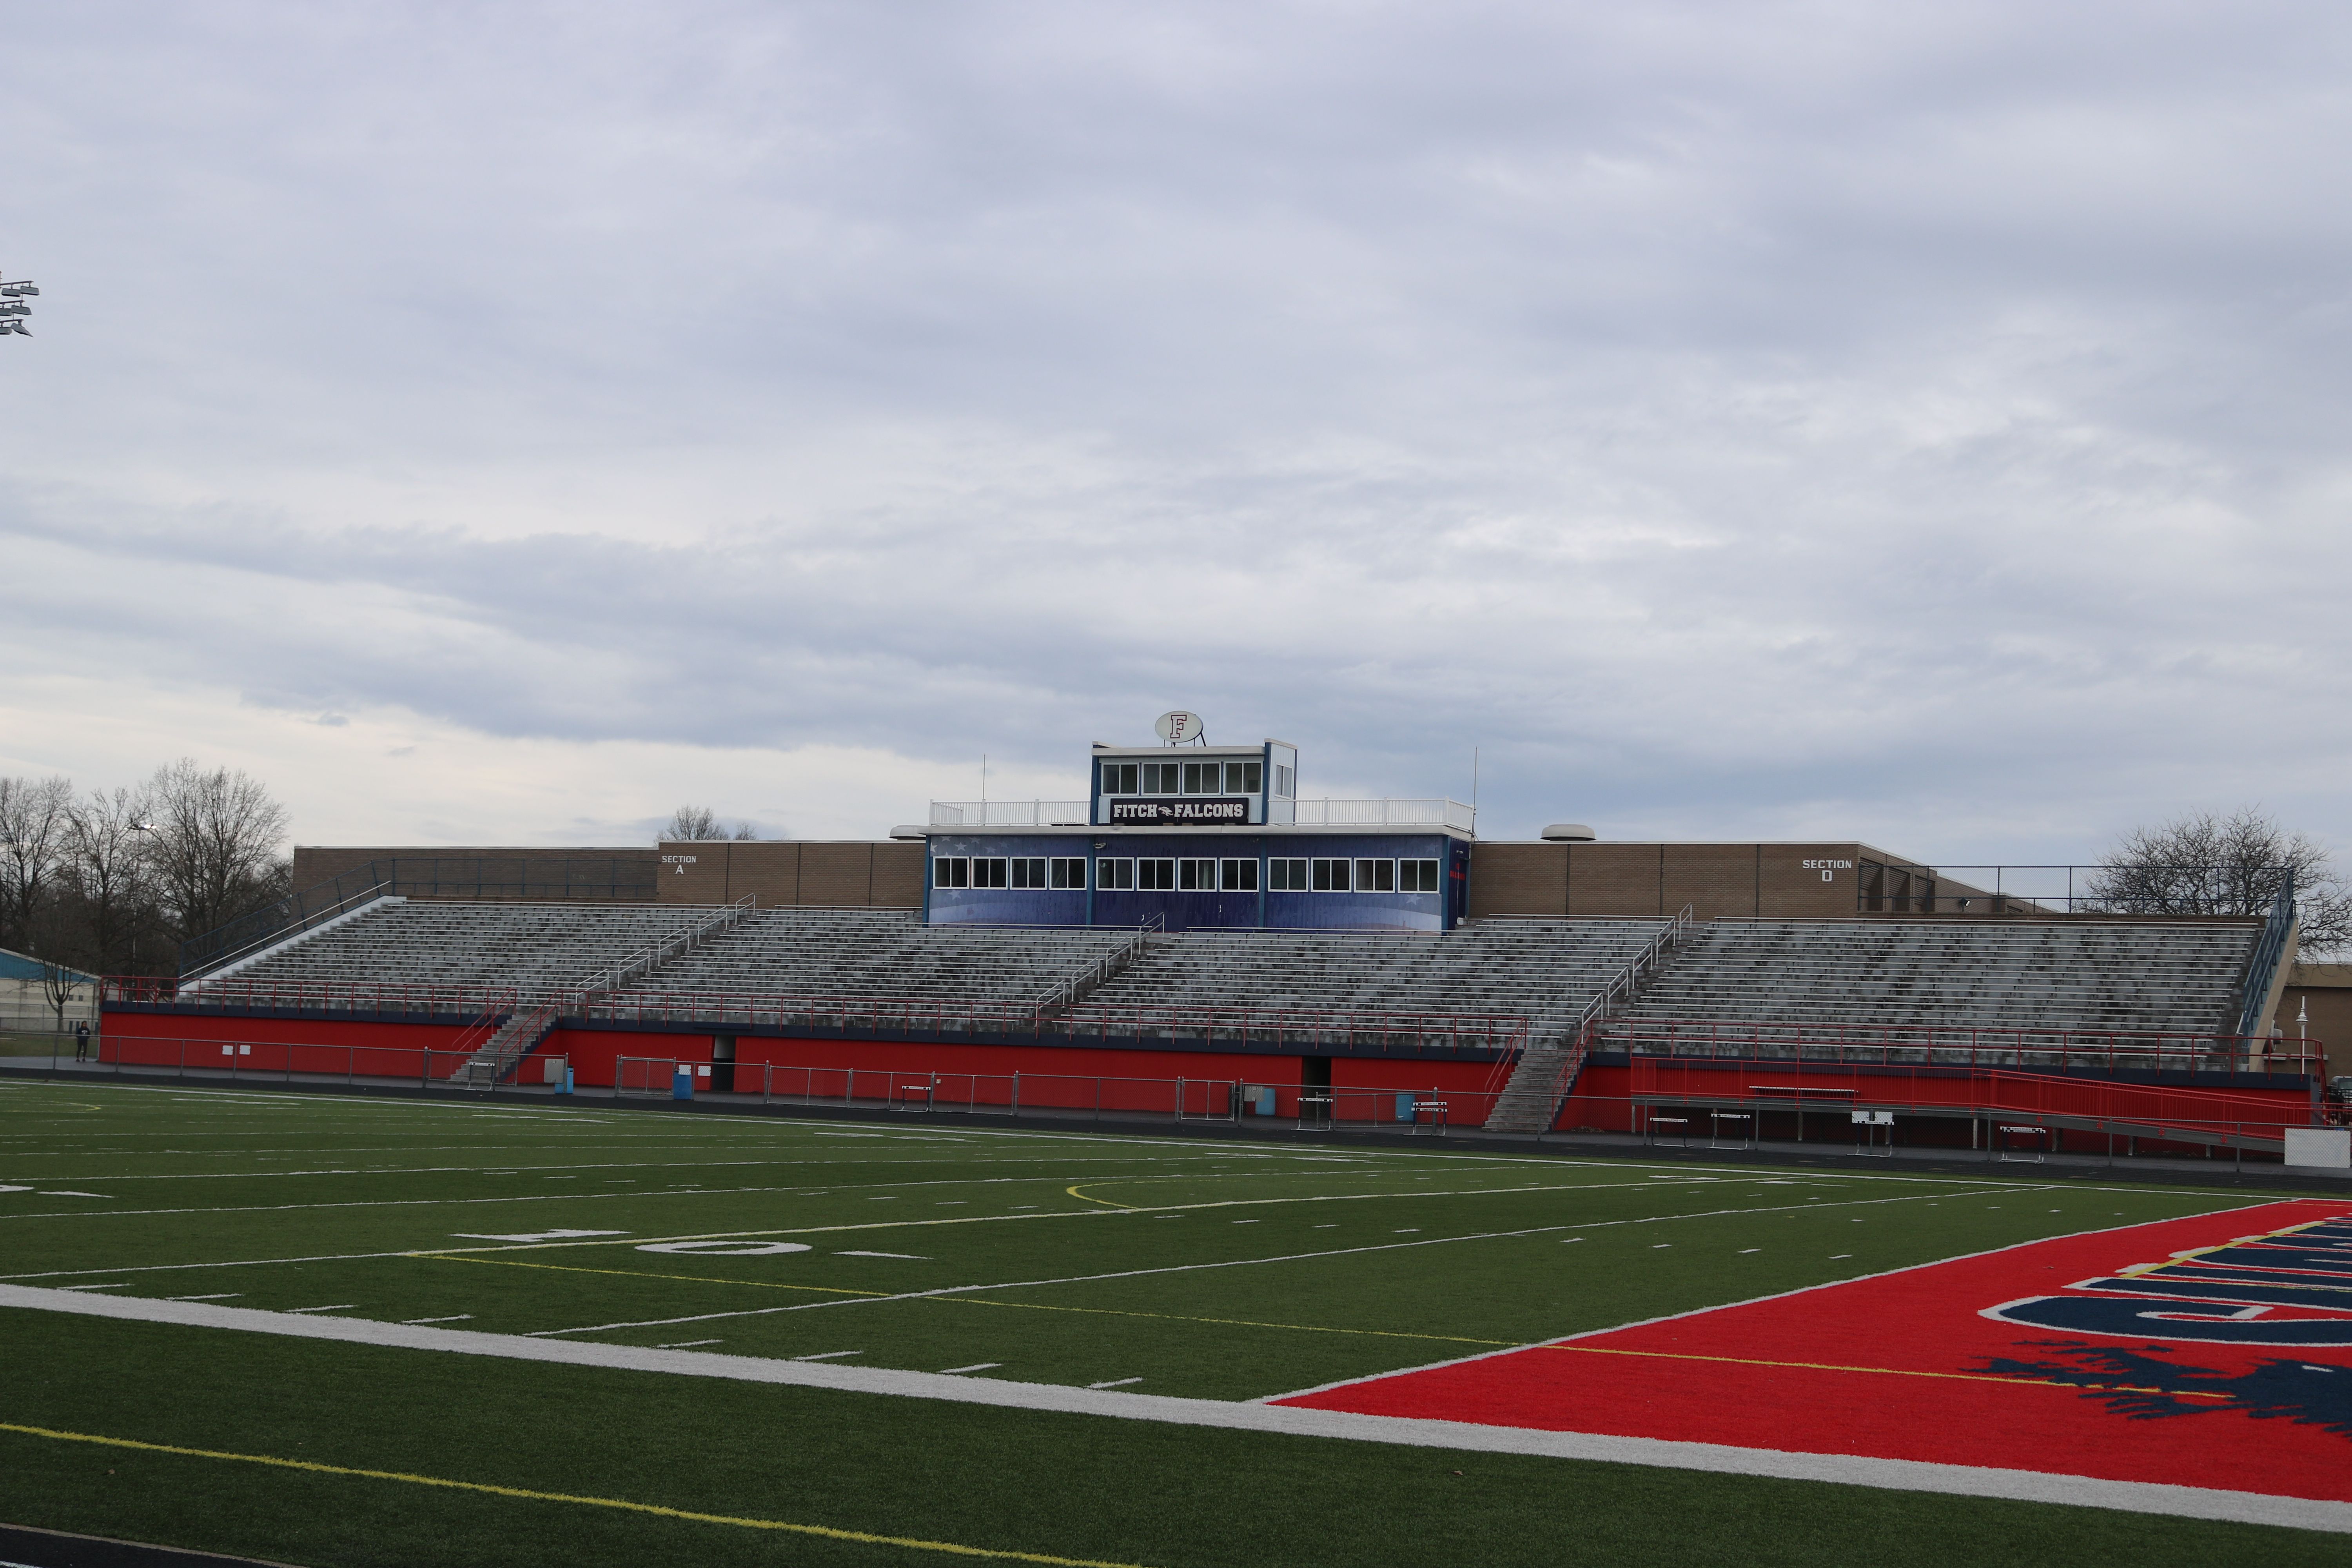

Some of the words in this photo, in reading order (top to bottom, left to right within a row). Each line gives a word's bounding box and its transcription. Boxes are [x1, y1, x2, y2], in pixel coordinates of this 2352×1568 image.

[1170, 714, 1187, 739] F
[1114, 804, 1158, 818] FITCH
[1174, 804, 1243, 817] FALCONS
[675, 864, 684, 875] A
[1802, 860, 1852, 869] SECTION
[1822, 870, 1833, 882] D
